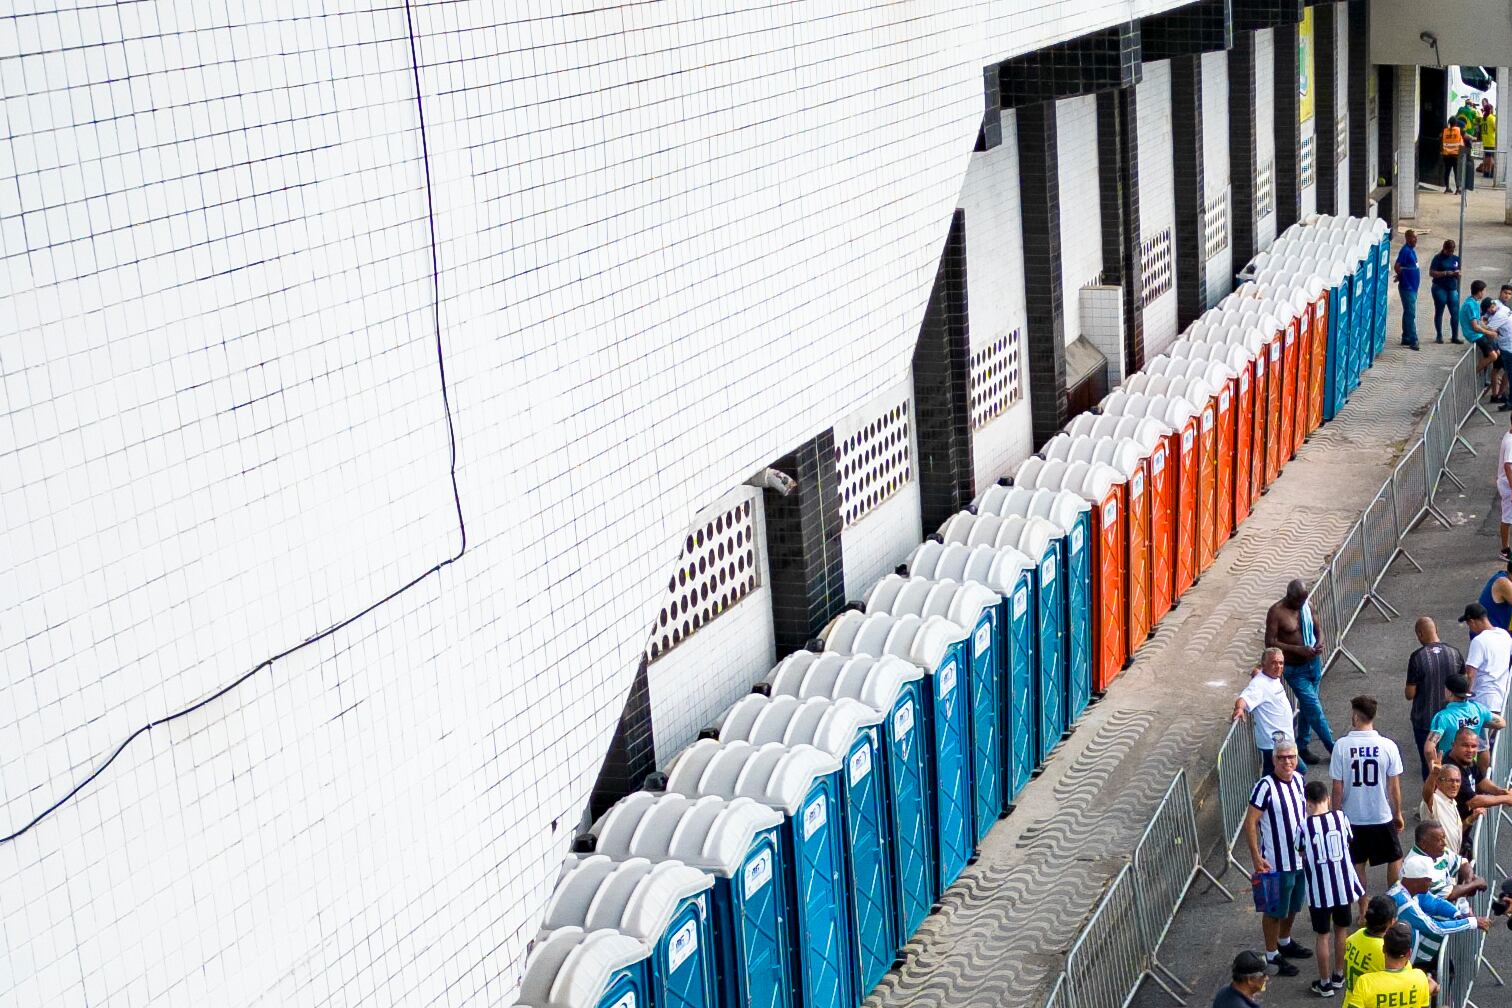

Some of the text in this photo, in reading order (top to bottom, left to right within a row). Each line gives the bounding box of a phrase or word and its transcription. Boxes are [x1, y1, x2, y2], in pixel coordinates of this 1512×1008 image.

[1351, 759, 1379, 787] 10
[1313, 830, 1344, 864] 10
[1376, 985, 1417, 1008] PELÉ
